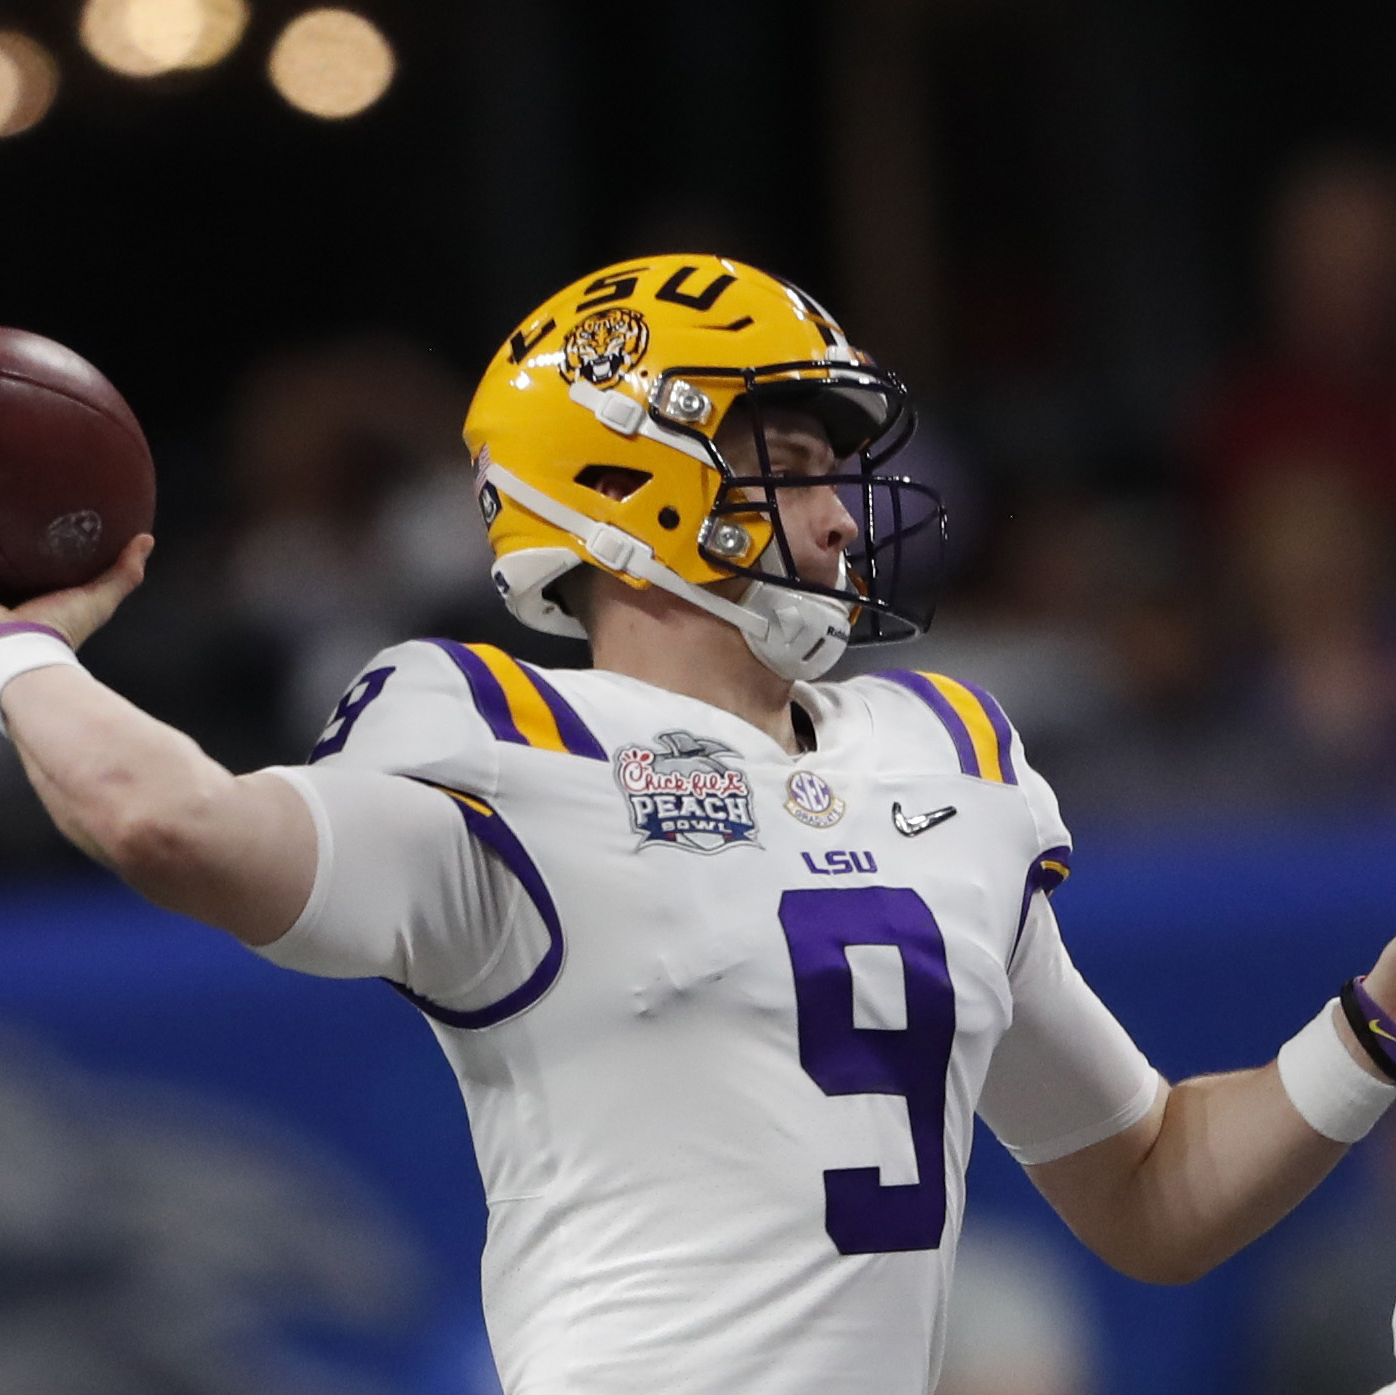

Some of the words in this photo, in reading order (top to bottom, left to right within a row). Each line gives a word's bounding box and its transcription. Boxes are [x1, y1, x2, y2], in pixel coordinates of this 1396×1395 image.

[508, 266, 739, 365] LSU
[307, 666, 396, 765] 9
[631, 794, 753, 828] PEACH
[791, 772, 830, 812] SEC
[661, 819, 732, 833] BOWL
[801, 850, 878, 876] LSU
[778, 886, 956, 1256] 9
